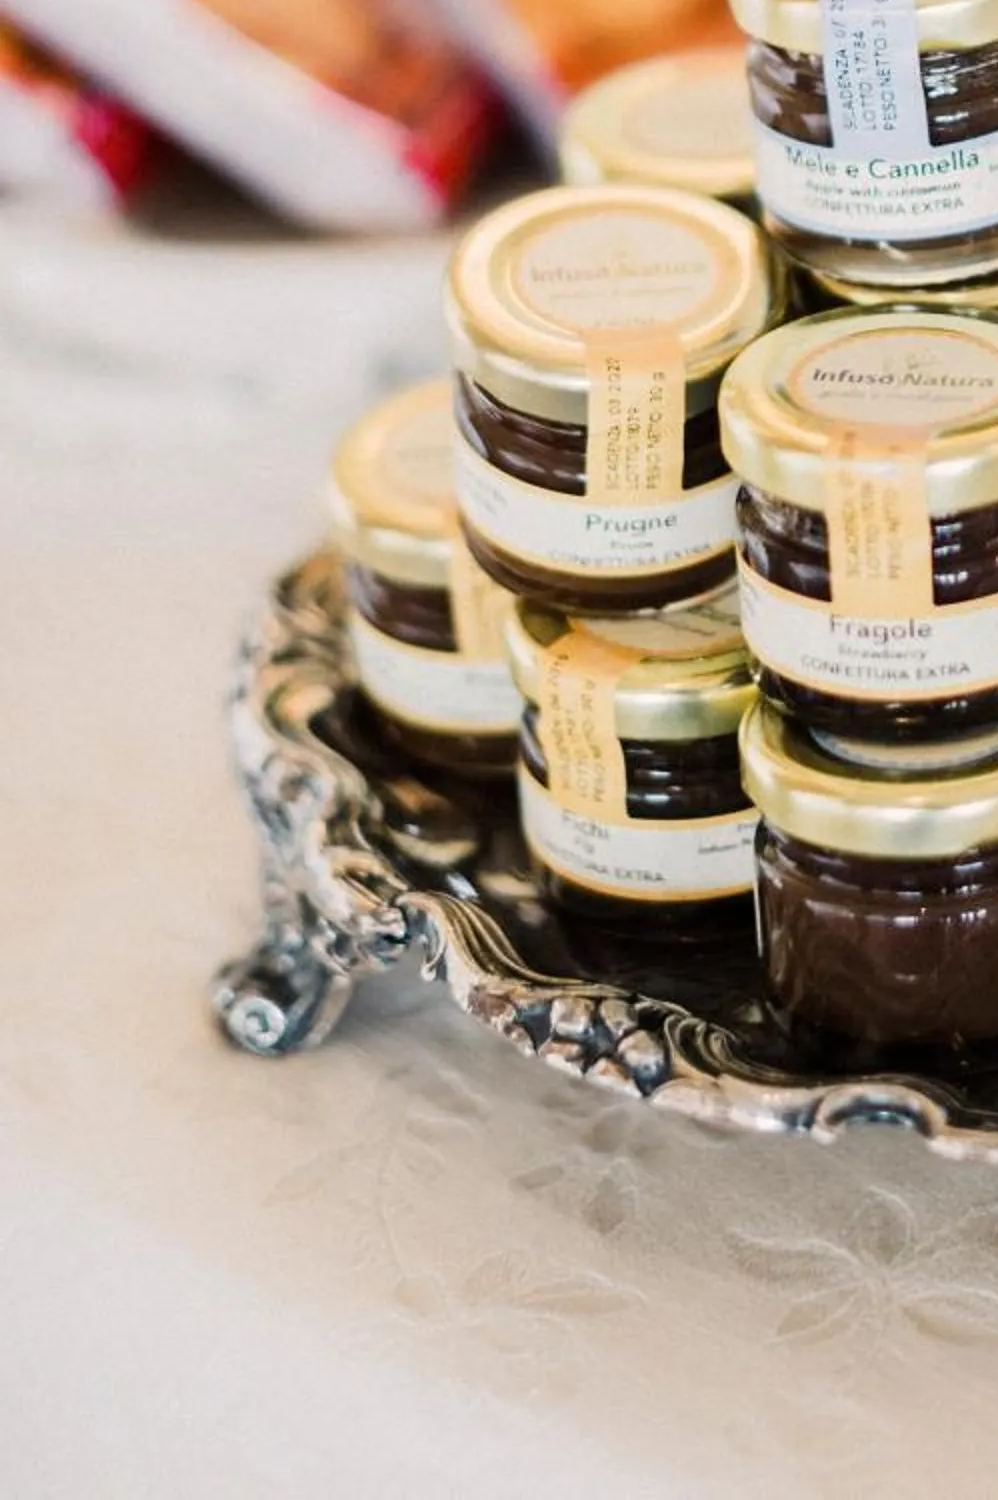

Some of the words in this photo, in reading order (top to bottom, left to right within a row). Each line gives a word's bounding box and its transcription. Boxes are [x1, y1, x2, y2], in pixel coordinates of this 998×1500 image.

[874, 37, 892, 88] NETTO
[860, 81, 877, 131] LOTTO
[880, 89, 897, 131] PESO
[785, 146, 837, 178] Mele
[846, 166, 860, 178] e
[867, 150, 979, 181] Cannella
[849, 183, 883, 198] with
[911, 197, 965, 215] EXTRA
[811, 367, 896, 387] Infuso
[901, 371, 995, 389] Natura
[585, 513, 678, 537] Prugne
[829, 614, 934, 645] Fragole
[799, 654, 909, 682] CONFETTURA
[917, 663, 971, 682] EXTRA
[614, 866, 666, 883] EXTRA
